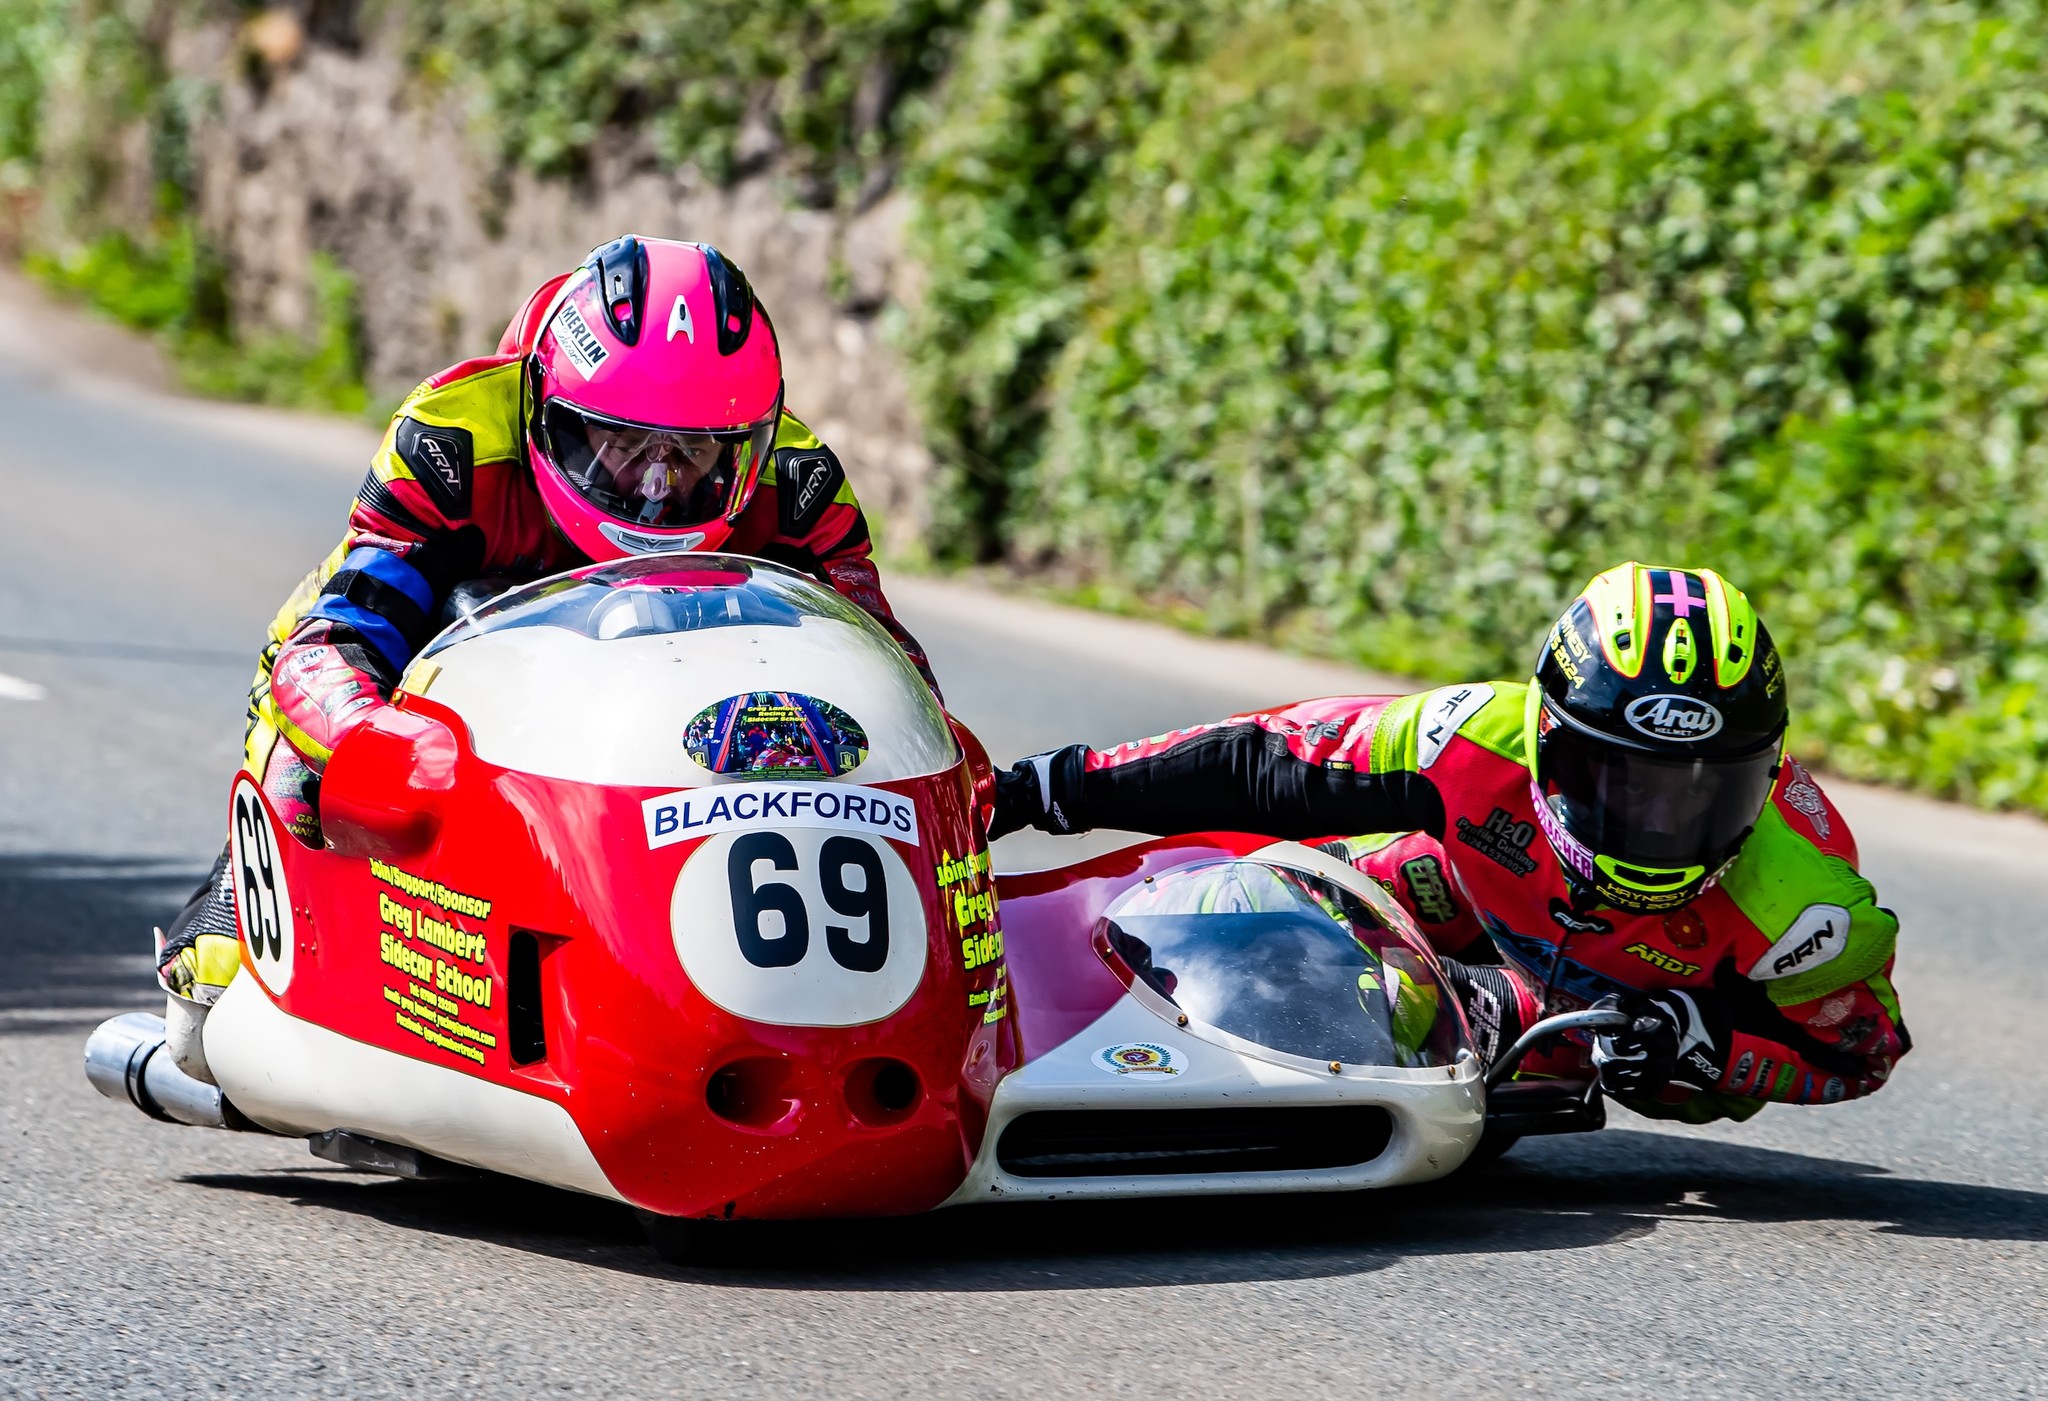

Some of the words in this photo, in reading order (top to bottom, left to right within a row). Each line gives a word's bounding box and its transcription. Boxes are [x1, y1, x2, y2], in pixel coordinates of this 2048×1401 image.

[561, 304, 607, 364] MERLIN
[421, 438, 460, 484] ARN
[798, 460, 827, 509] ARN
[1630, 697, 1714, 731] Arai
[654, 791, 913, 837] BLACKFORDS
[1485, 809, 1534, 847] H2O
[1458, 817, 1495, 843] Profile
[1496, 838, 1536, 872] Cutting
[236, 793, 282, 963] 69
[727, 831, 891, 973] 69
[1607, 883, 1689, 902] HAYNESY
[379, 892, 413, 939] Greg
[416, 908, 487, 964] Lambert
[955, 889, 995, 927] Greg
[380, 932, 434, 984] Sidecar
[435, 958, 493, 1009] School
[1773, 919, 1835, 975] ARN
[1688, 1050, 1723, 1081] FIVE
